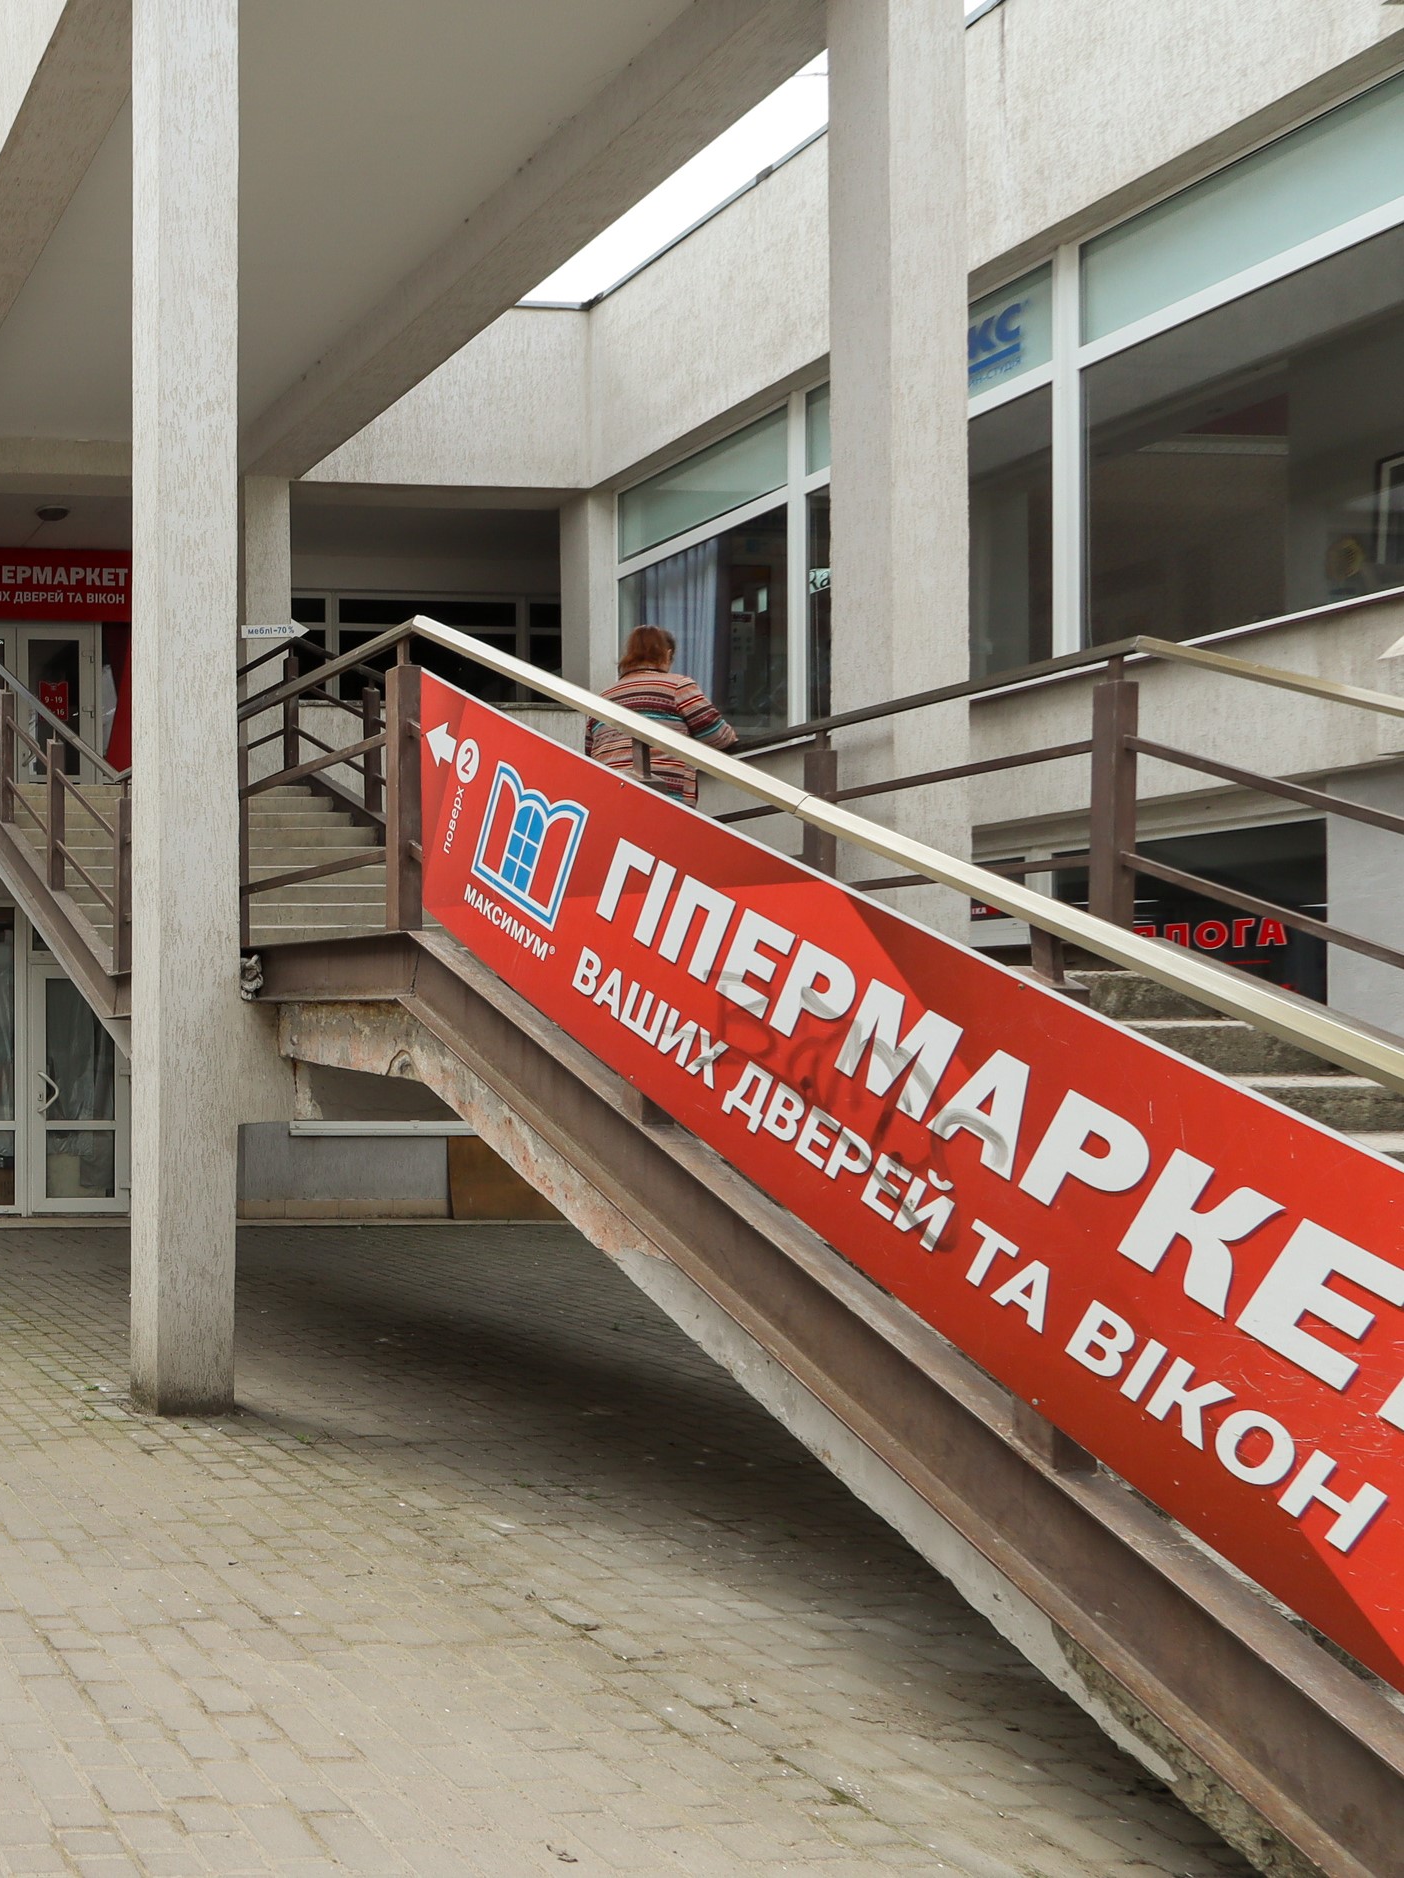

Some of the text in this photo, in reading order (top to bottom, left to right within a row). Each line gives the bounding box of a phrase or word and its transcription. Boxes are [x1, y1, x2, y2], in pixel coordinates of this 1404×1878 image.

[13, 589, 64, 604] ДВЕРЕЙ
[66, 592, 84, 603] ТА
[87, 592, 125, 604] ВІКОН
[460, 747, 474, 775] 2
[443, 786, 465, 854] поверх
[571, 946, 729, 1088] ВАШИХ
[721, 1061, 955, 1252] ДВЕРЕЙ
[969, 1218, 1050, 1334] ТА
[1065, 1299, 1388, 1553] ВІКОН
